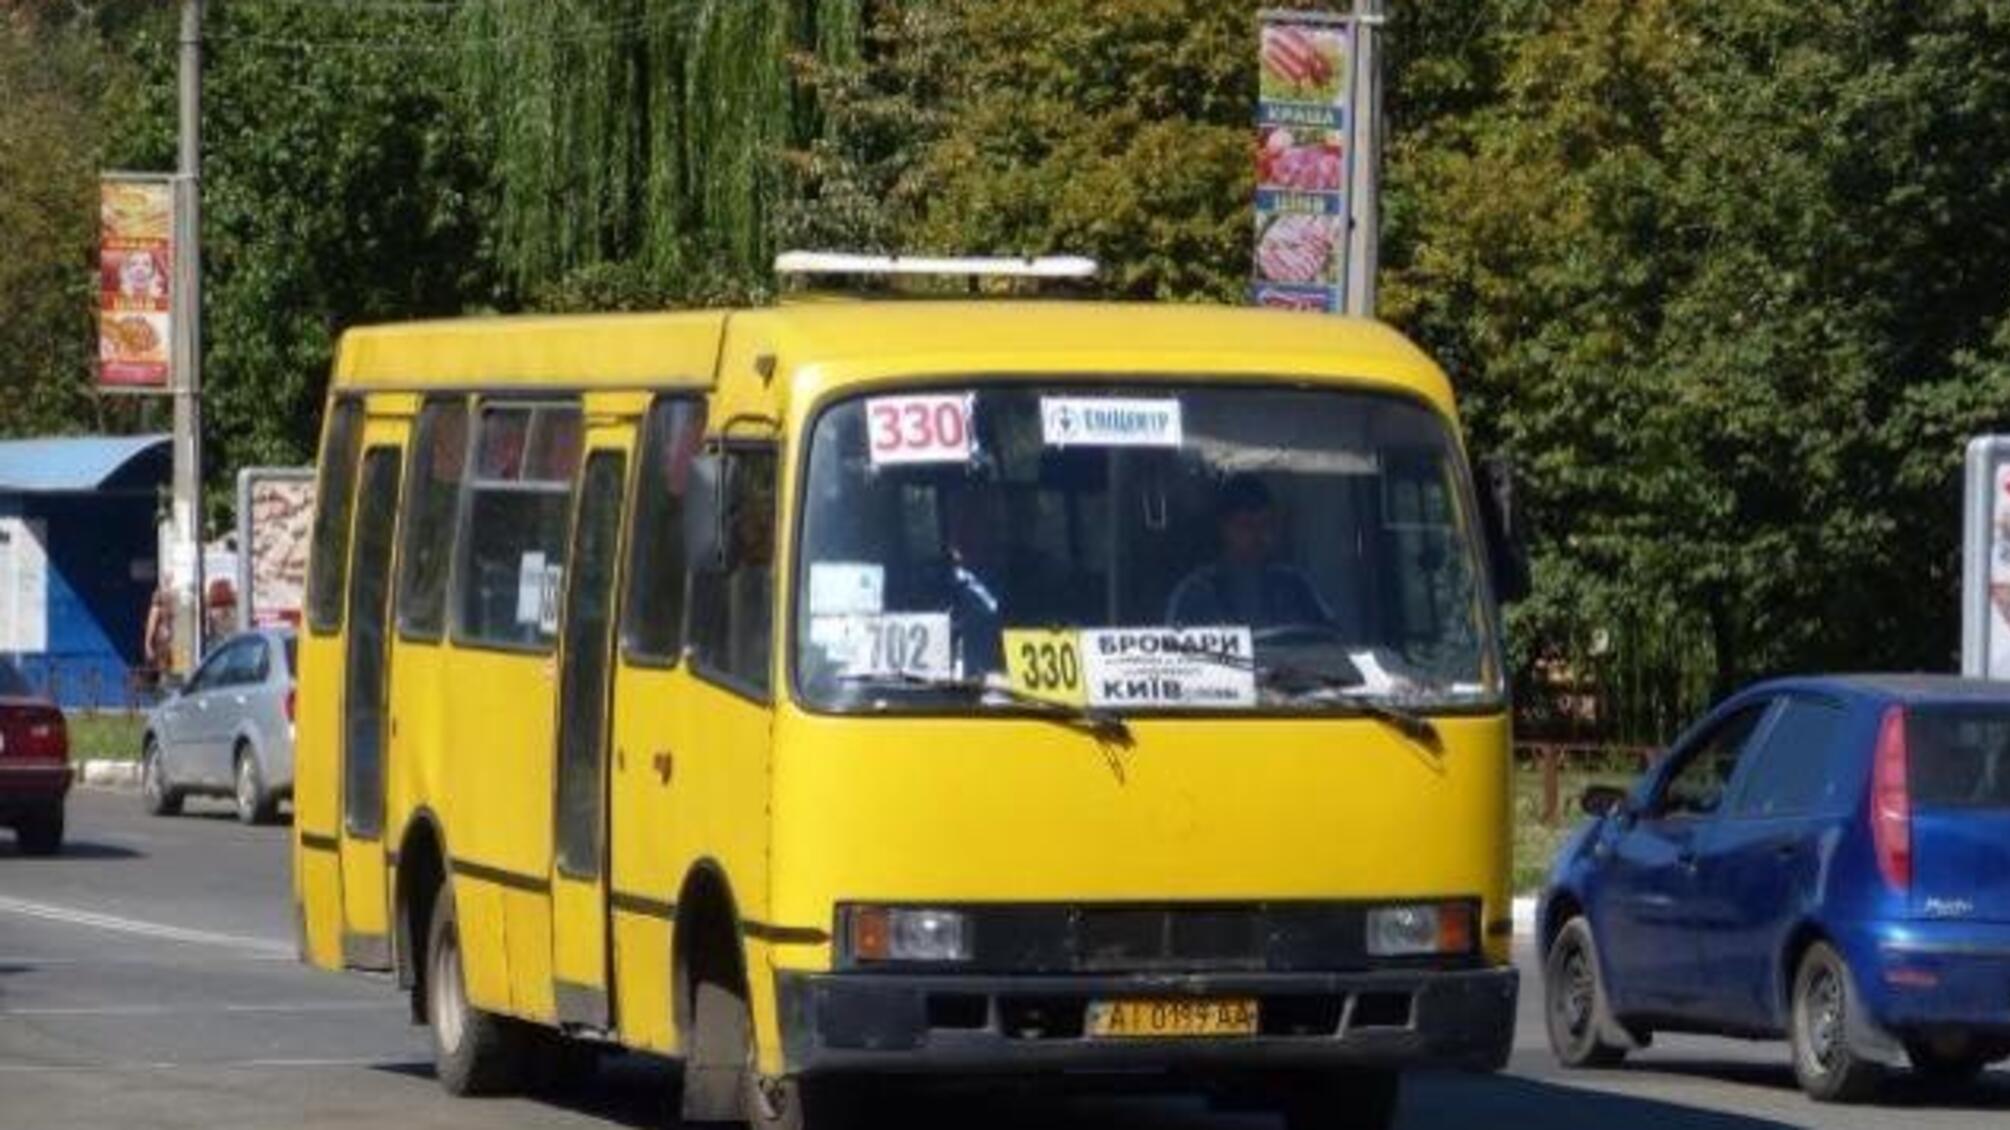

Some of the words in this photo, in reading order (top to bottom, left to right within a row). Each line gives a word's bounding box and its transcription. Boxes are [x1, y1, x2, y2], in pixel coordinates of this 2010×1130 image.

[872, 402, 963, 450] 330
[866, 621, 929, 670] 702
[1021, 642, 1078, 690] 330
[1100, 633, 1239, 655] БРОВАРИ
[1103, 674, 1182, 700] КИЇВ
